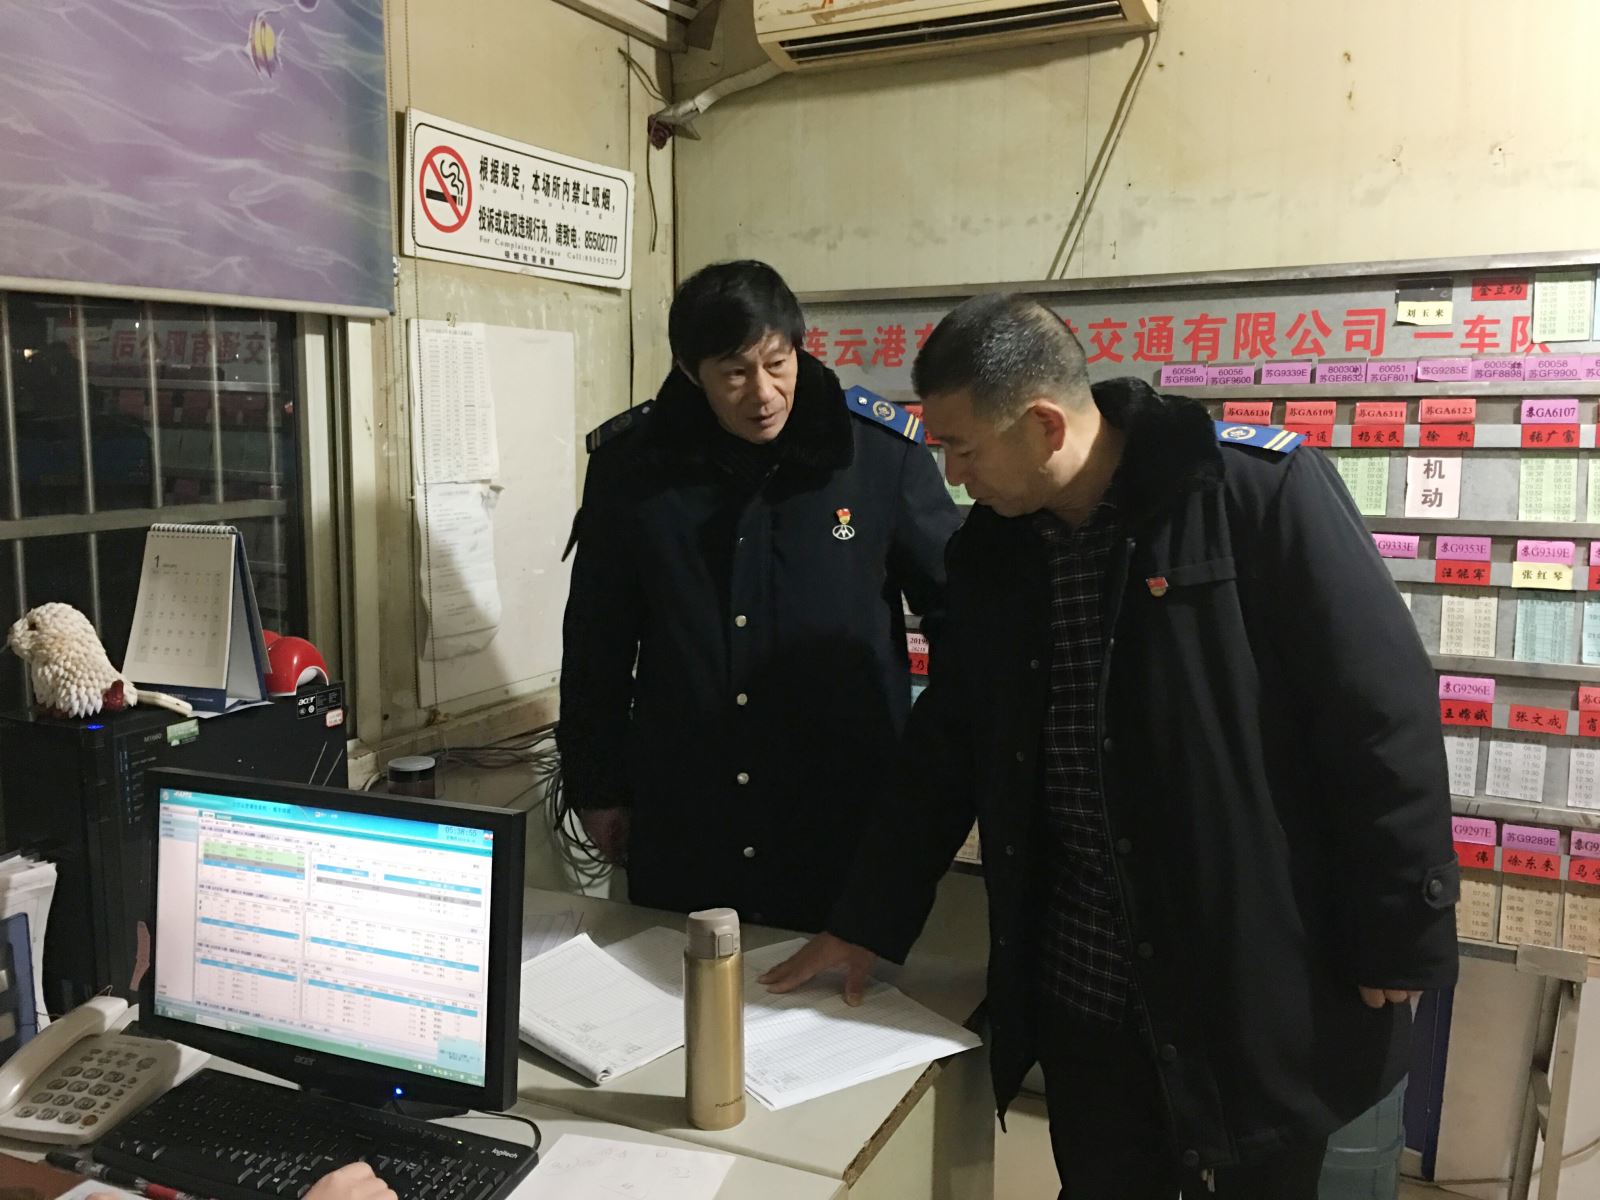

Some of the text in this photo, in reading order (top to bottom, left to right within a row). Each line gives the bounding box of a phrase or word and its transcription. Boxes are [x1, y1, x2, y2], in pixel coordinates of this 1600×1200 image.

[1379, 365, 1406, 373] 60051
[1538, 360, 1568, 369] 60058
[1172, 367, 1197, 375] 60054
[1218, 368, 1243, 376] 60056
[1265, 368, 1308, 378] 苏G9339E
[1421, 366, 1468, 375] 苏G9285E
[1529, 368, 1578, 378] 苏GF9900
[1164, 375, 1204, 384] 苏GF8890
[1210, 376, 1251, 385] 苏GF9600
[1227, 408, 1270, 417] 苏GA6130
[1289, 407, 1334, 417] 苏GA6109
[1425, 406, 1473, 415] 苏GA6123
[1421, 458, 1446, 508] 机动
[297, 695, 316, 706] acer
[1506, 832, 1557, 847] 苏G9289E
[491, 1147, 518, 1160] logitech
